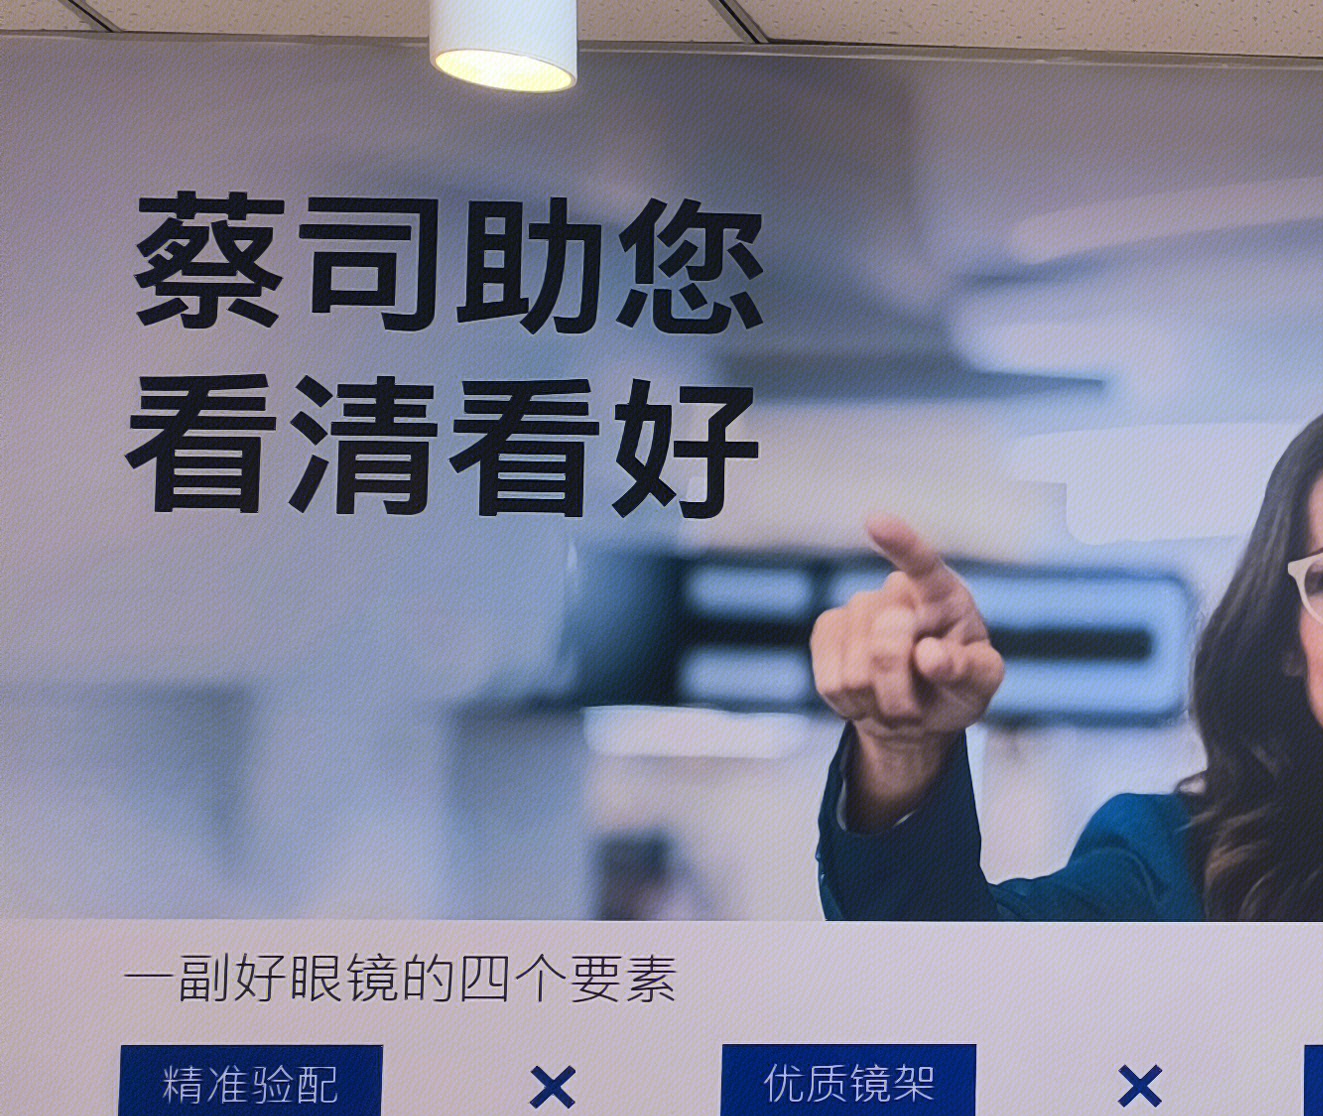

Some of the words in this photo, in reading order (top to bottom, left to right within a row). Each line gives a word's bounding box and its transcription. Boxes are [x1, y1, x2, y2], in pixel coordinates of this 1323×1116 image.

[134, 190, 764, 334] 蔡司助您
[125, 374, 759, 519] 看清看好
[124, 953, 677, 1003] 一副好眼镜的四个要素
[162, 1064, 338, 1104] 精准验配
[763, 1063, 935, 1103] 优质镜架
